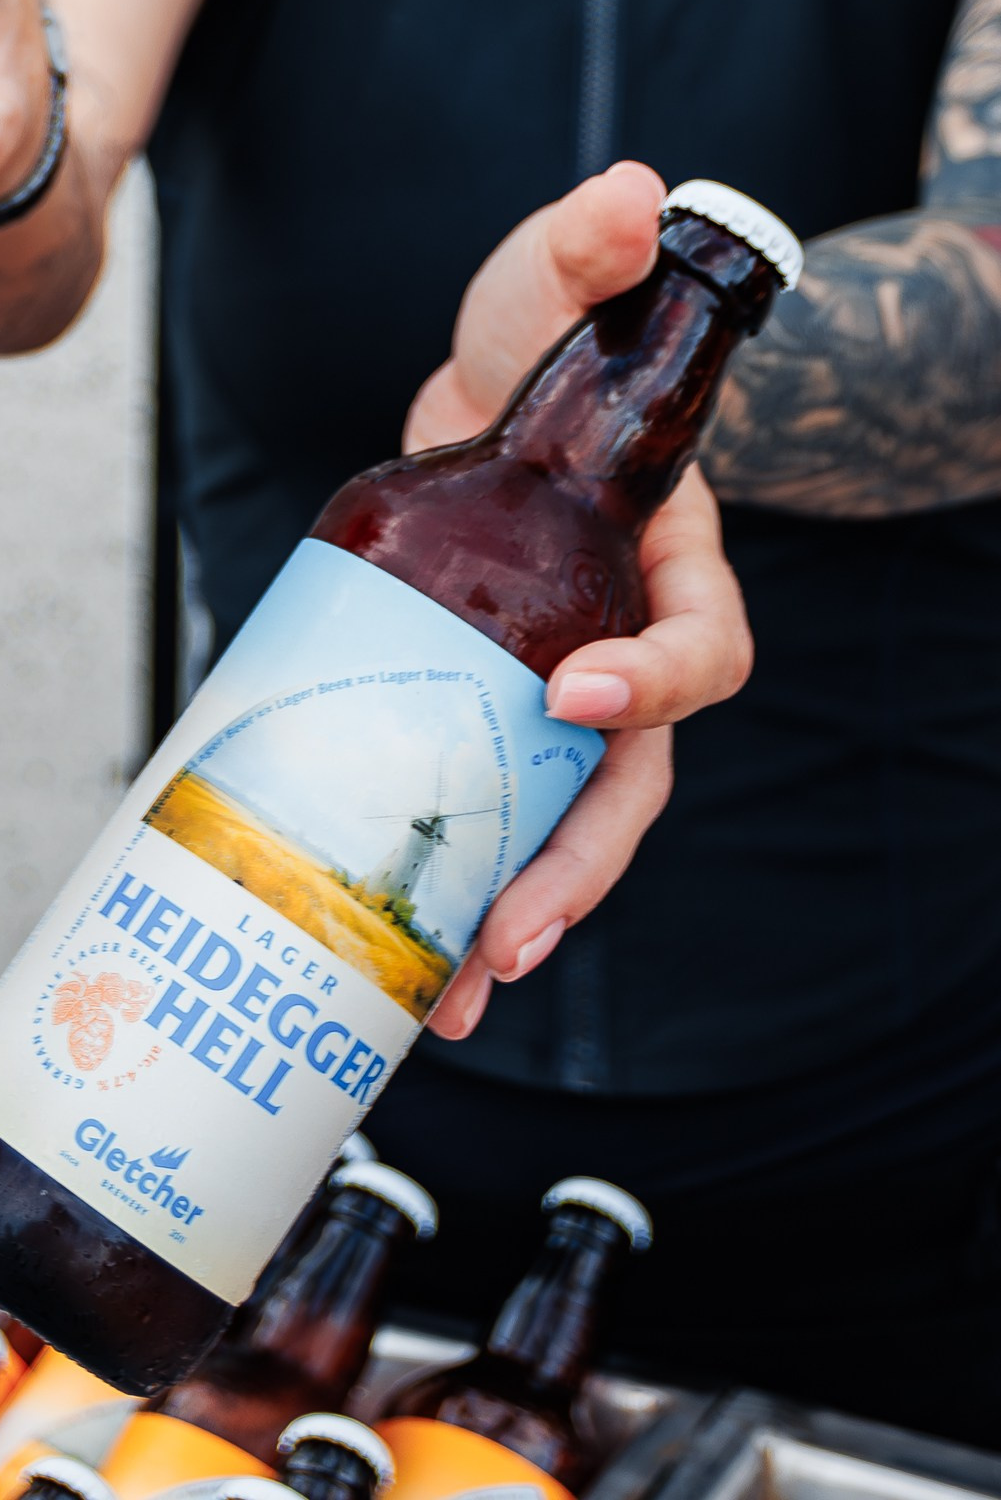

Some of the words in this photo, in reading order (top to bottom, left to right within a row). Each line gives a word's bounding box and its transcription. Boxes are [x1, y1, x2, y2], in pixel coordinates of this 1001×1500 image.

[275, 688, 315, 709] Lager
[379, 670, 422, 685] Lager
[425, 669, 461, 683] Beer
[97, 871, 388, 1106] HEIDEGGER
[235, 913, 339, 997] LAGER
[31, 1034, 85, 1090] GERMAN
[67, 942, 122, 967] LAGER
[127, 947, 165, 985] BEER
[144, 978, 295, 1117] HELL
[74, 1117, 206, 1226] Gletcher
[100, 1179, 150, 1216] BREWERY
